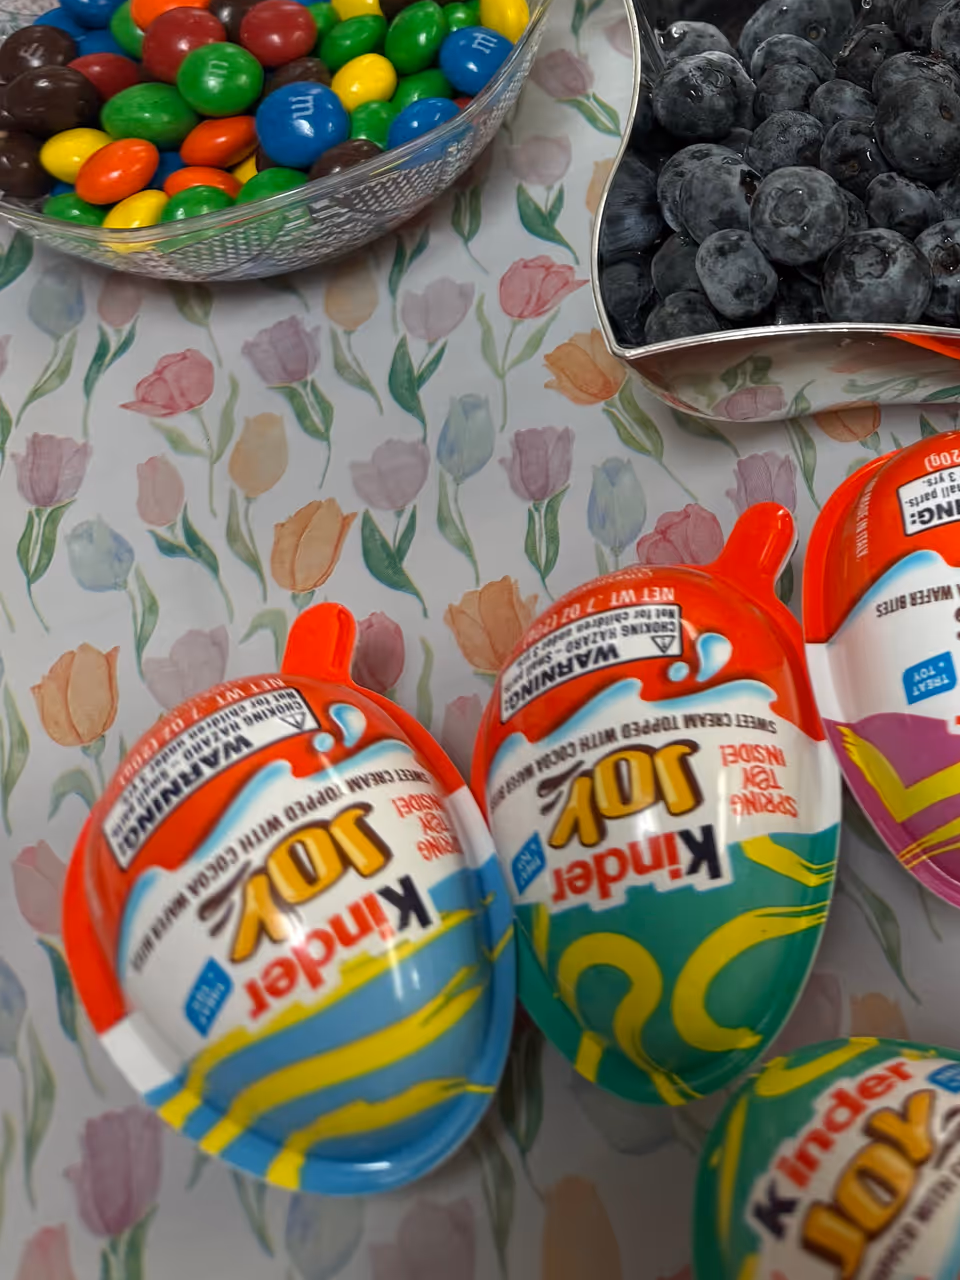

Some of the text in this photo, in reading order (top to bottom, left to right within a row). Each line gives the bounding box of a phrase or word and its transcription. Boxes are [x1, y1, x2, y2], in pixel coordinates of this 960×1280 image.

[922, 473, 945, 488] yrs.
[948, 471, 955, 481] 3
[904, 491, 938, 508] parts.
[610, 589, 636, 606] WT
[641, 586, 675, 601] NET
[911, 584, 953, 607] WAFER
[576, 608, 675, 632] Not for children
[876, 598, 907, 617] BITES
[565, 621, 676, 653] CHOKING HAZARD
[504, 643, 620, 712] WARNING:
[911, 673, 950, 697] TREAT
[913, 664, 937, 682] TOY
[249, 696, 269, 708] for
[273, 690, 298, 700] Not
[242, 700, 304, 727] CHOKING
[535, 713, 777, 773] SWEET CREAM TOPPED WITH COCOA
[718, 743, 787, 768] INSIDE!
[741, 764, 785, 791] TOY
[118, 734, 254, 858] WARNING:
[547, 739, 704, 849] JOY
[729, 791, 798, 818] SPRING
[187, 768, 395, 898] CREAM WITH COCOA
[551, 823, 723, 903] Kinder
[228, 801, 395, 965] JOY
[243, 874, 433, 1020] Kinder
[753, 1062, 913, 1242] Kinder
[798, 1088, 937, 1280] JOY
